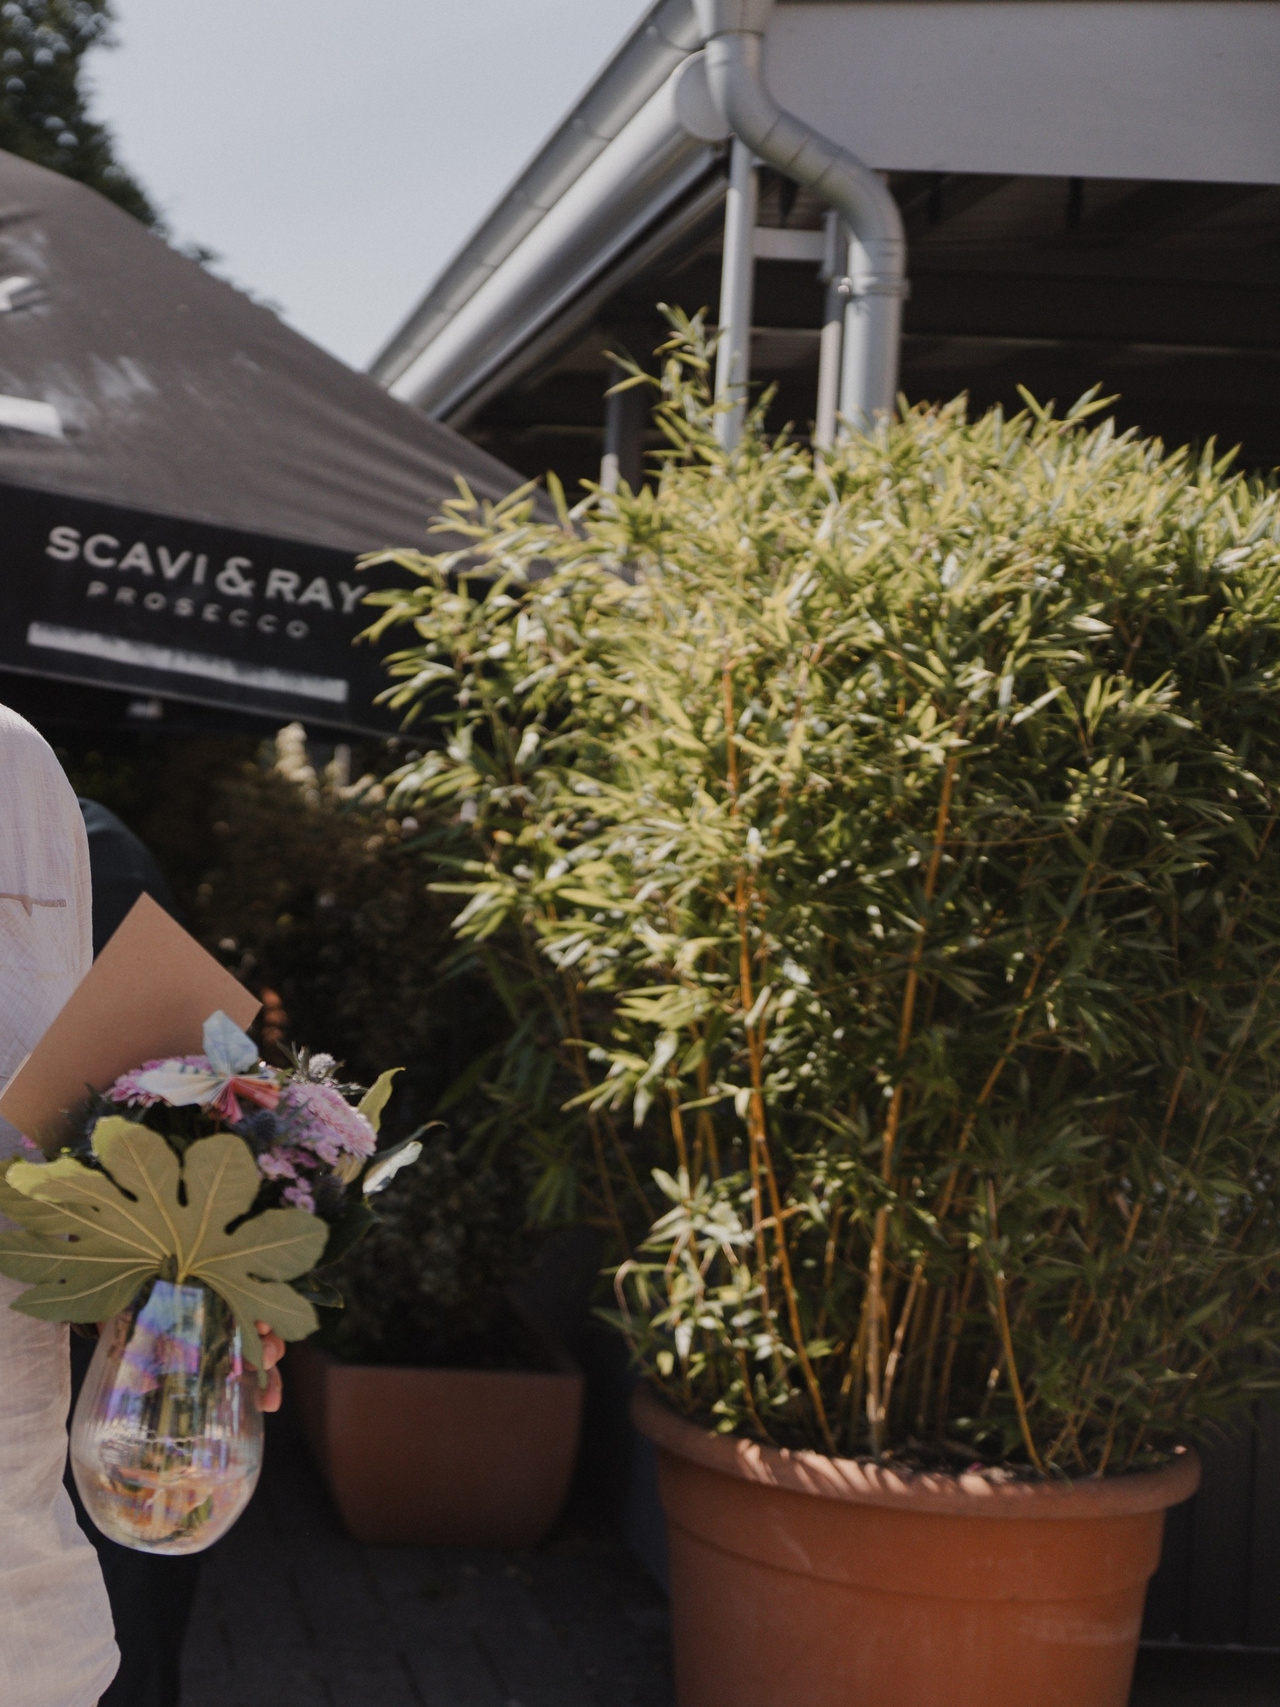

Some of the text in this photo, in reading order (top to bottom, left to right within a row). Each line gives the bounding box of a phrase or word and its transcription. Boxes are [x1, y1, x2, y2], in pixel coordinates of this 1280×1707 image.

[45, 526, 368, 614] SCAVI & RAY
[86, 580, 310, 640] PROSECCO
